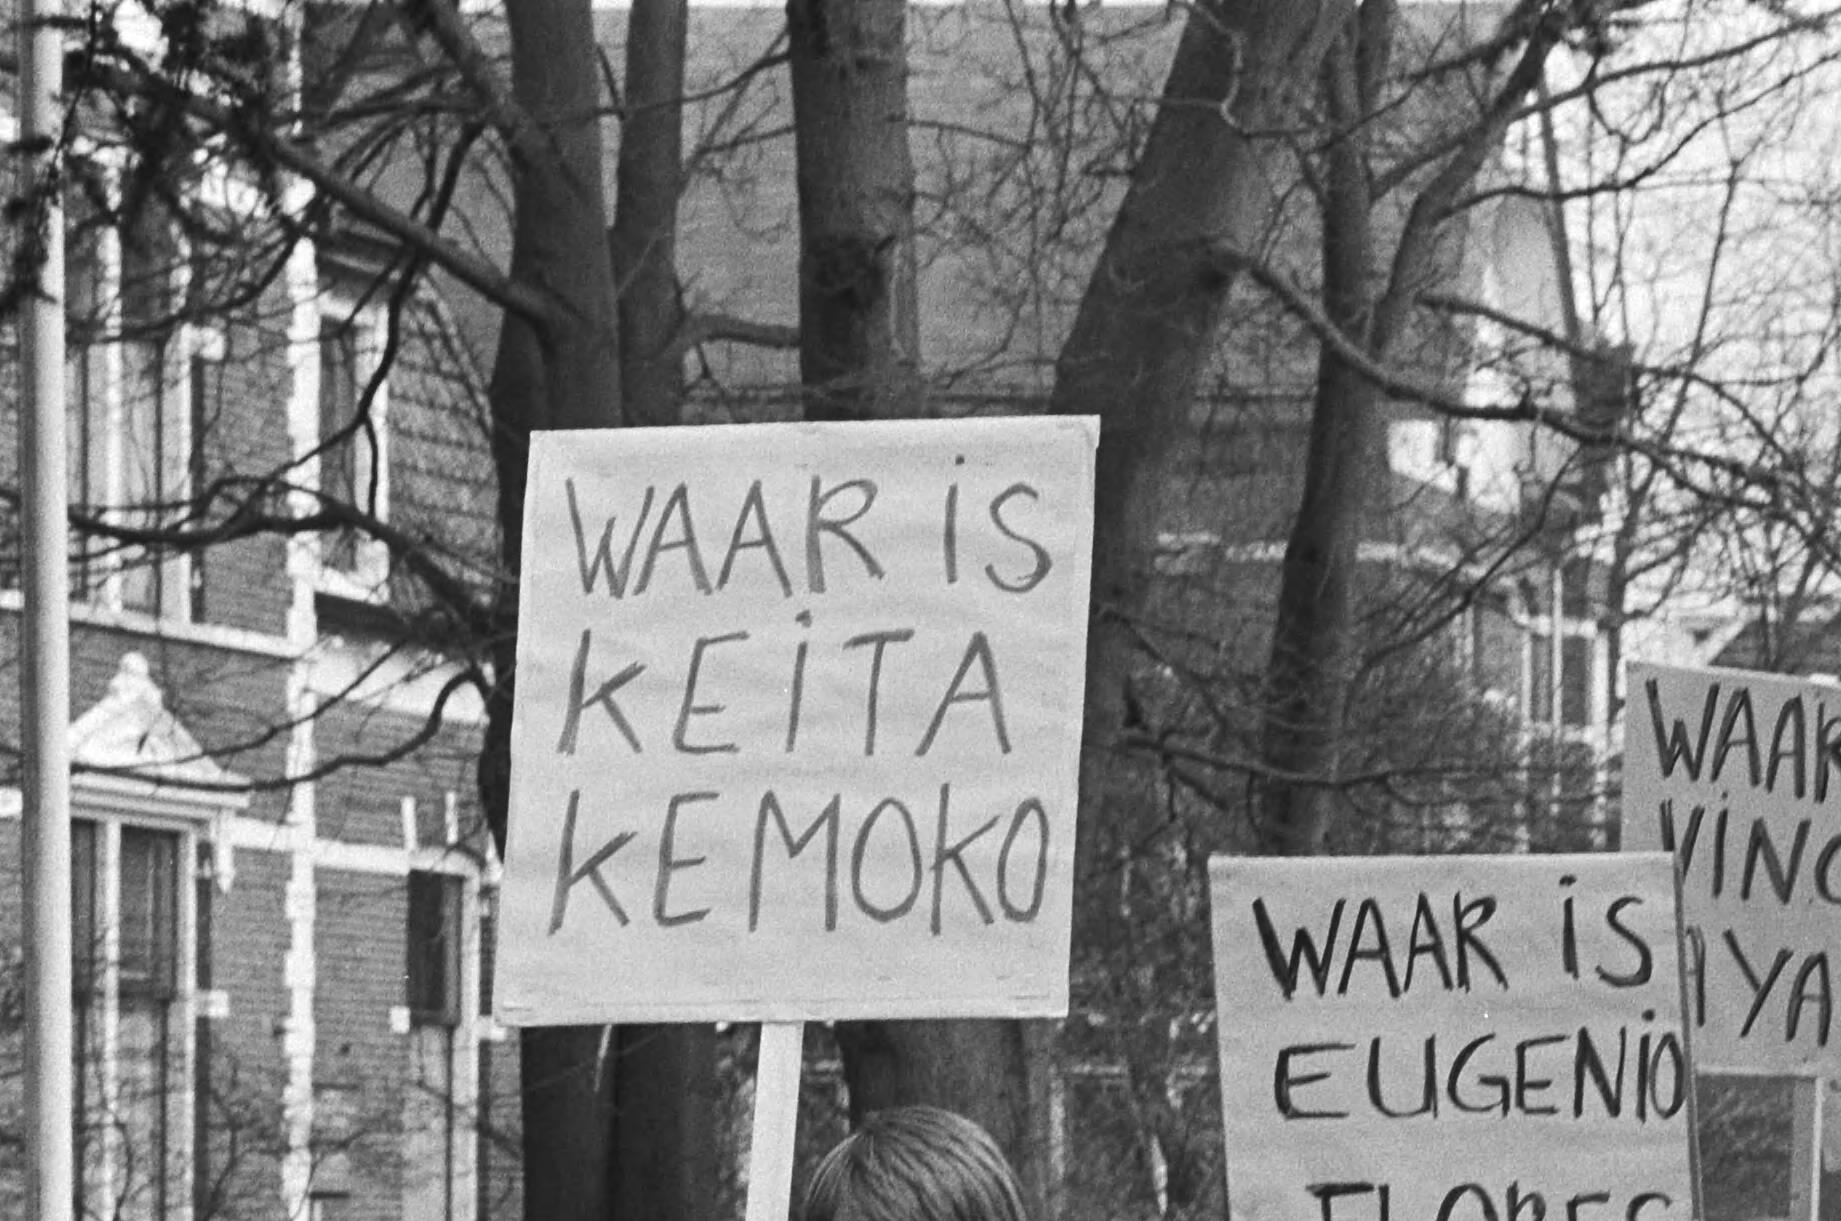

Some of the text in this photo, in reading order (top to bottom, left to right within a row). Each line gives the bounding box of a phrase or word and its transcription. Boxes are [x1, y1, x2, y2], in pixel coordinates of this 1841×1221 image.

[565, 474, 885, 600] WAAR
[548, 782, 1050, 937] KEMOKO
[1252, 890, 1508, 1000] WAAR
